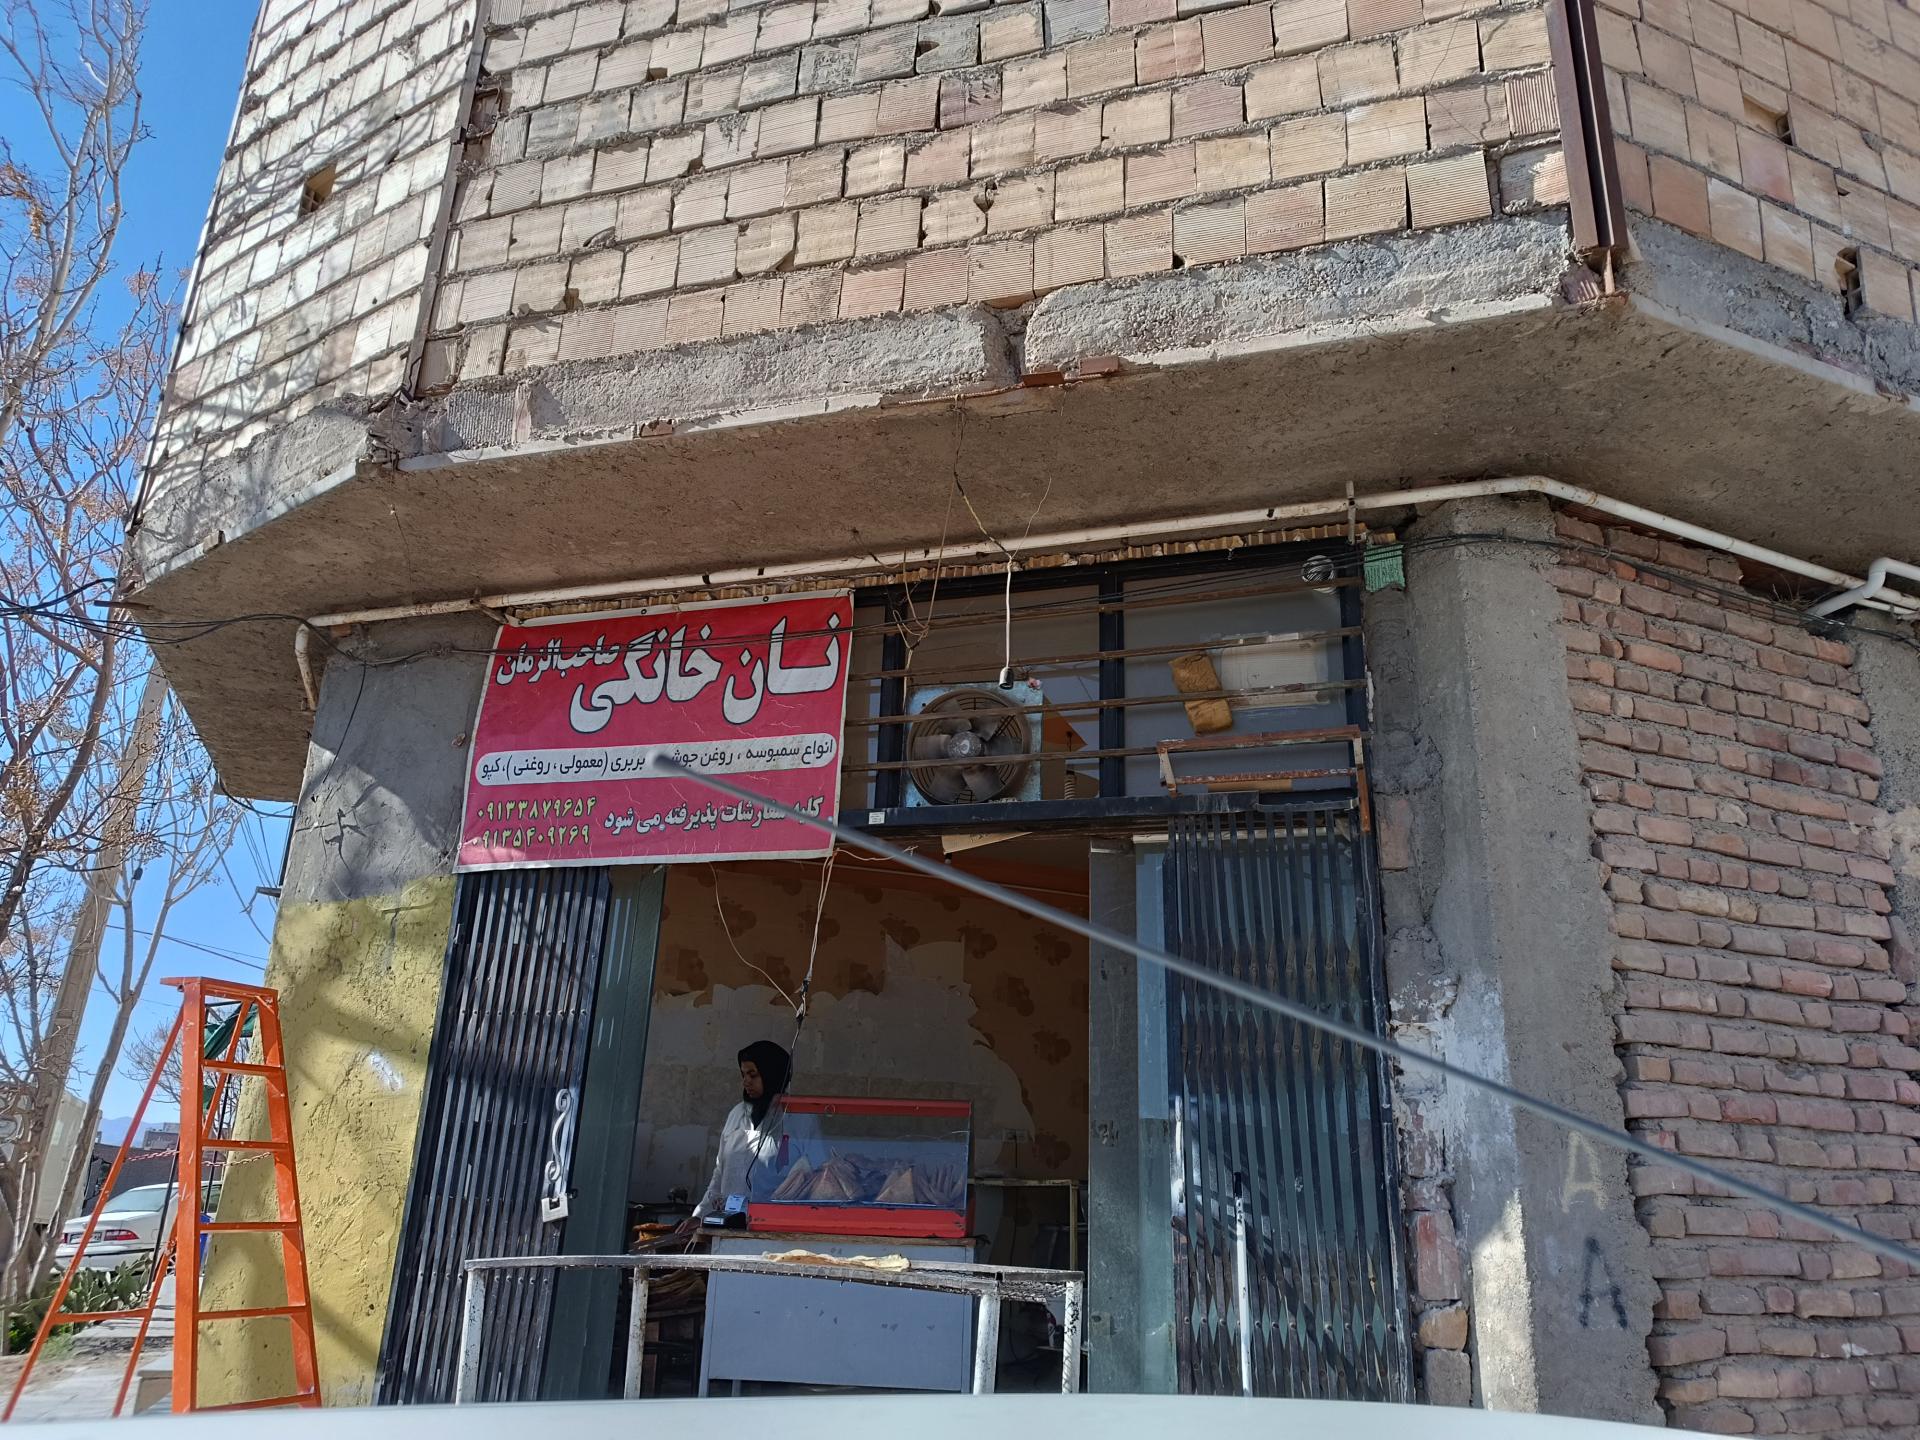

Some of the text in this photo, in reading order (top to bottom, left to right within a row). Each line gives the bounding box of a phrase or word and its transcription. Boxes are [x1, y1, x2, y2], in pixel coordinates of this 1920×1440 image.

[568, 613, 840, 733] نان خانگی
[611, 755, 646, 772] بربری
[700, 747, 734, 768] روغن
[801, 739, 833, 765] انواع
[477, 796, 597, 821] ۰۹۱۳۳۸۷۹۶۵۴
[604, 807, 634, 835] شود
[664, 801, 718, 830] پذیرفته
[636, 810, 662, 834] می
